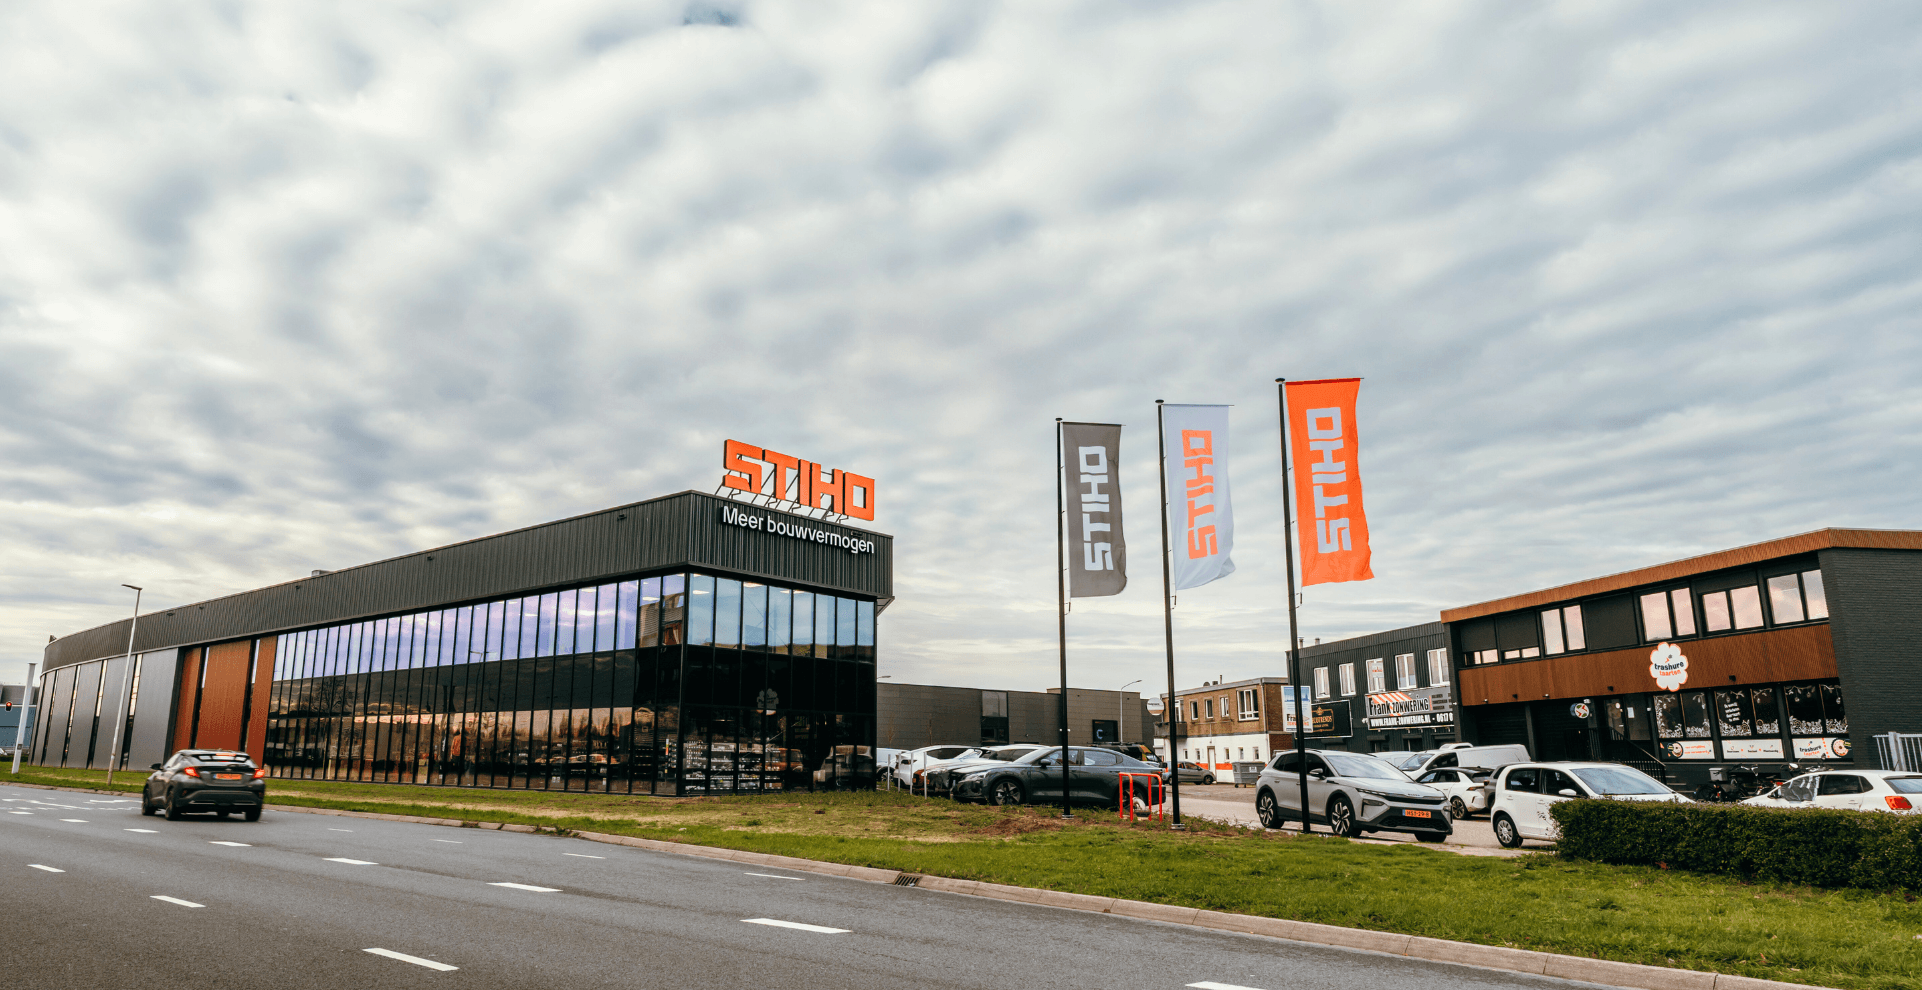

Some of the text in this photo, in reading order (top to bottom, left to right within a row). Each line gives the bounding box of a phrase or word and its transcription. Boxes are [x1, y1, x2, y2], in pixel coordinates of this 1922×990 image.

[723, 439, 875, 521] STIHO
[1078, 445, 1114, 571] STIHO
[1181, 429, 1218, 560] STIHO
[1306, 406, 1352, 554] STIHO
[723, 506, 875, 554] Meer bouwvermogen
[1654, 661, 1684, 671] trashure
[1369, 698, 1391, 716] Frank
[1799, 745, 1822, 753] trashure
